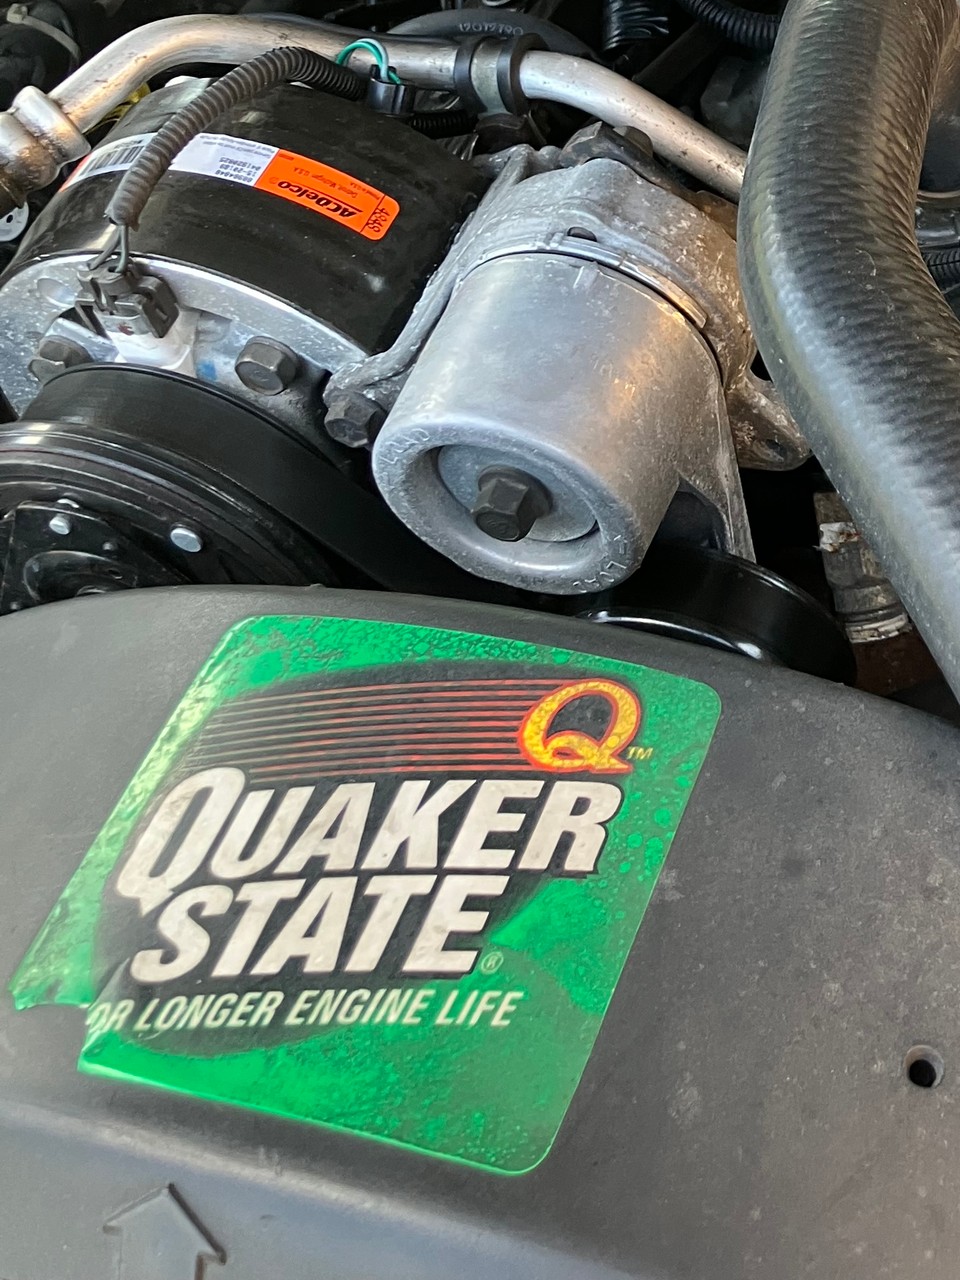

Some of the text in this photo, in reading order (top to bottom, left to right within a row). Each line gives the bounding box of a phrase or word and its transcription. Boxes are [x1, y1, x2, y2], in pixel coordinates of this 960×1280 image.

[277, 180, 358, 218] ACDelco
[517, 676, 643, 774] Q
[113, 767, 624, 918] QUAKER
[129, 874, 513, 984] STATE
[132, 990, 285, 1031] LONGER
[284, 987, 436, 1026] ENGINE
[435, 989, 525, 1027] LIFE
